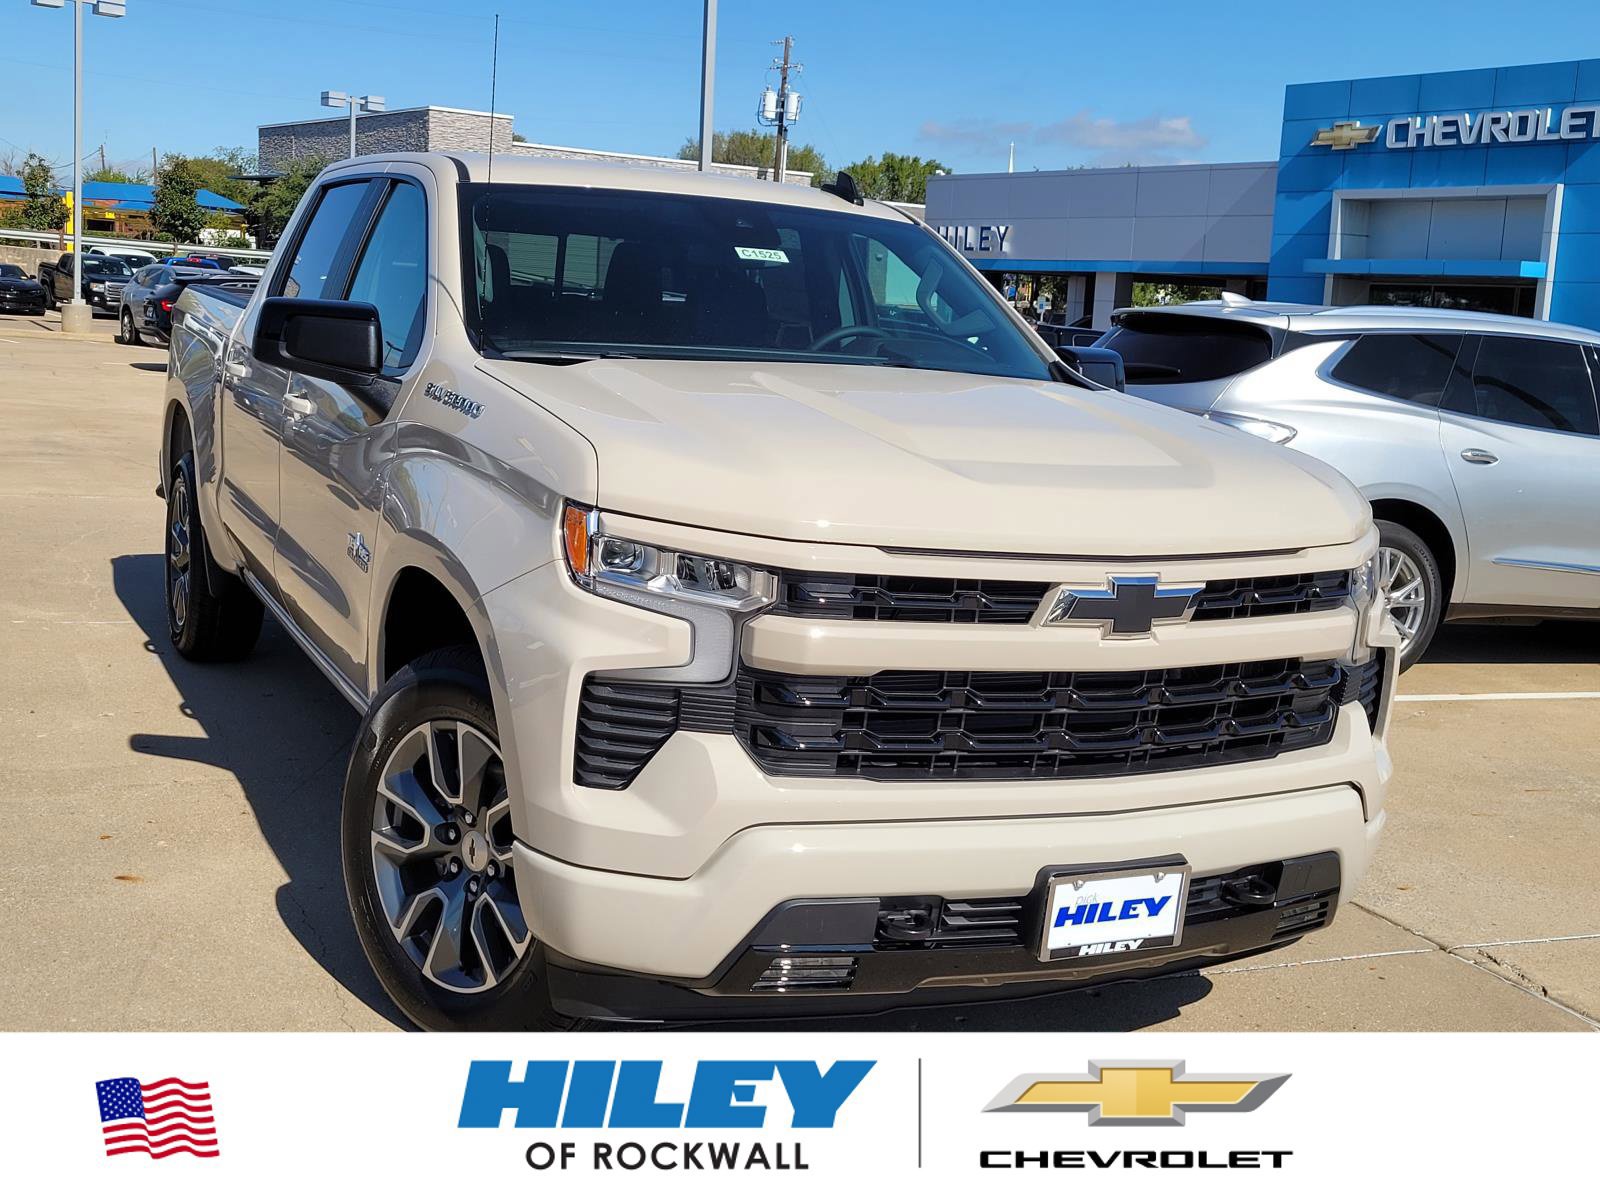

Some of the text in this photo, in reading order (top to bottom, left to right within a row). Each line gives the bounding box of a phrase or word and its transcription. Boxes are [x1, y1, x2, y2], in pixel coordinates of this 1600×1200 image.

[1386, 106, 1600, 149] CHEVROLET
[741, 249, 782, 260] C1525
[1054, 895, 1172, 928] HILEY
[1078, 939, 1144, 957] HILEY
